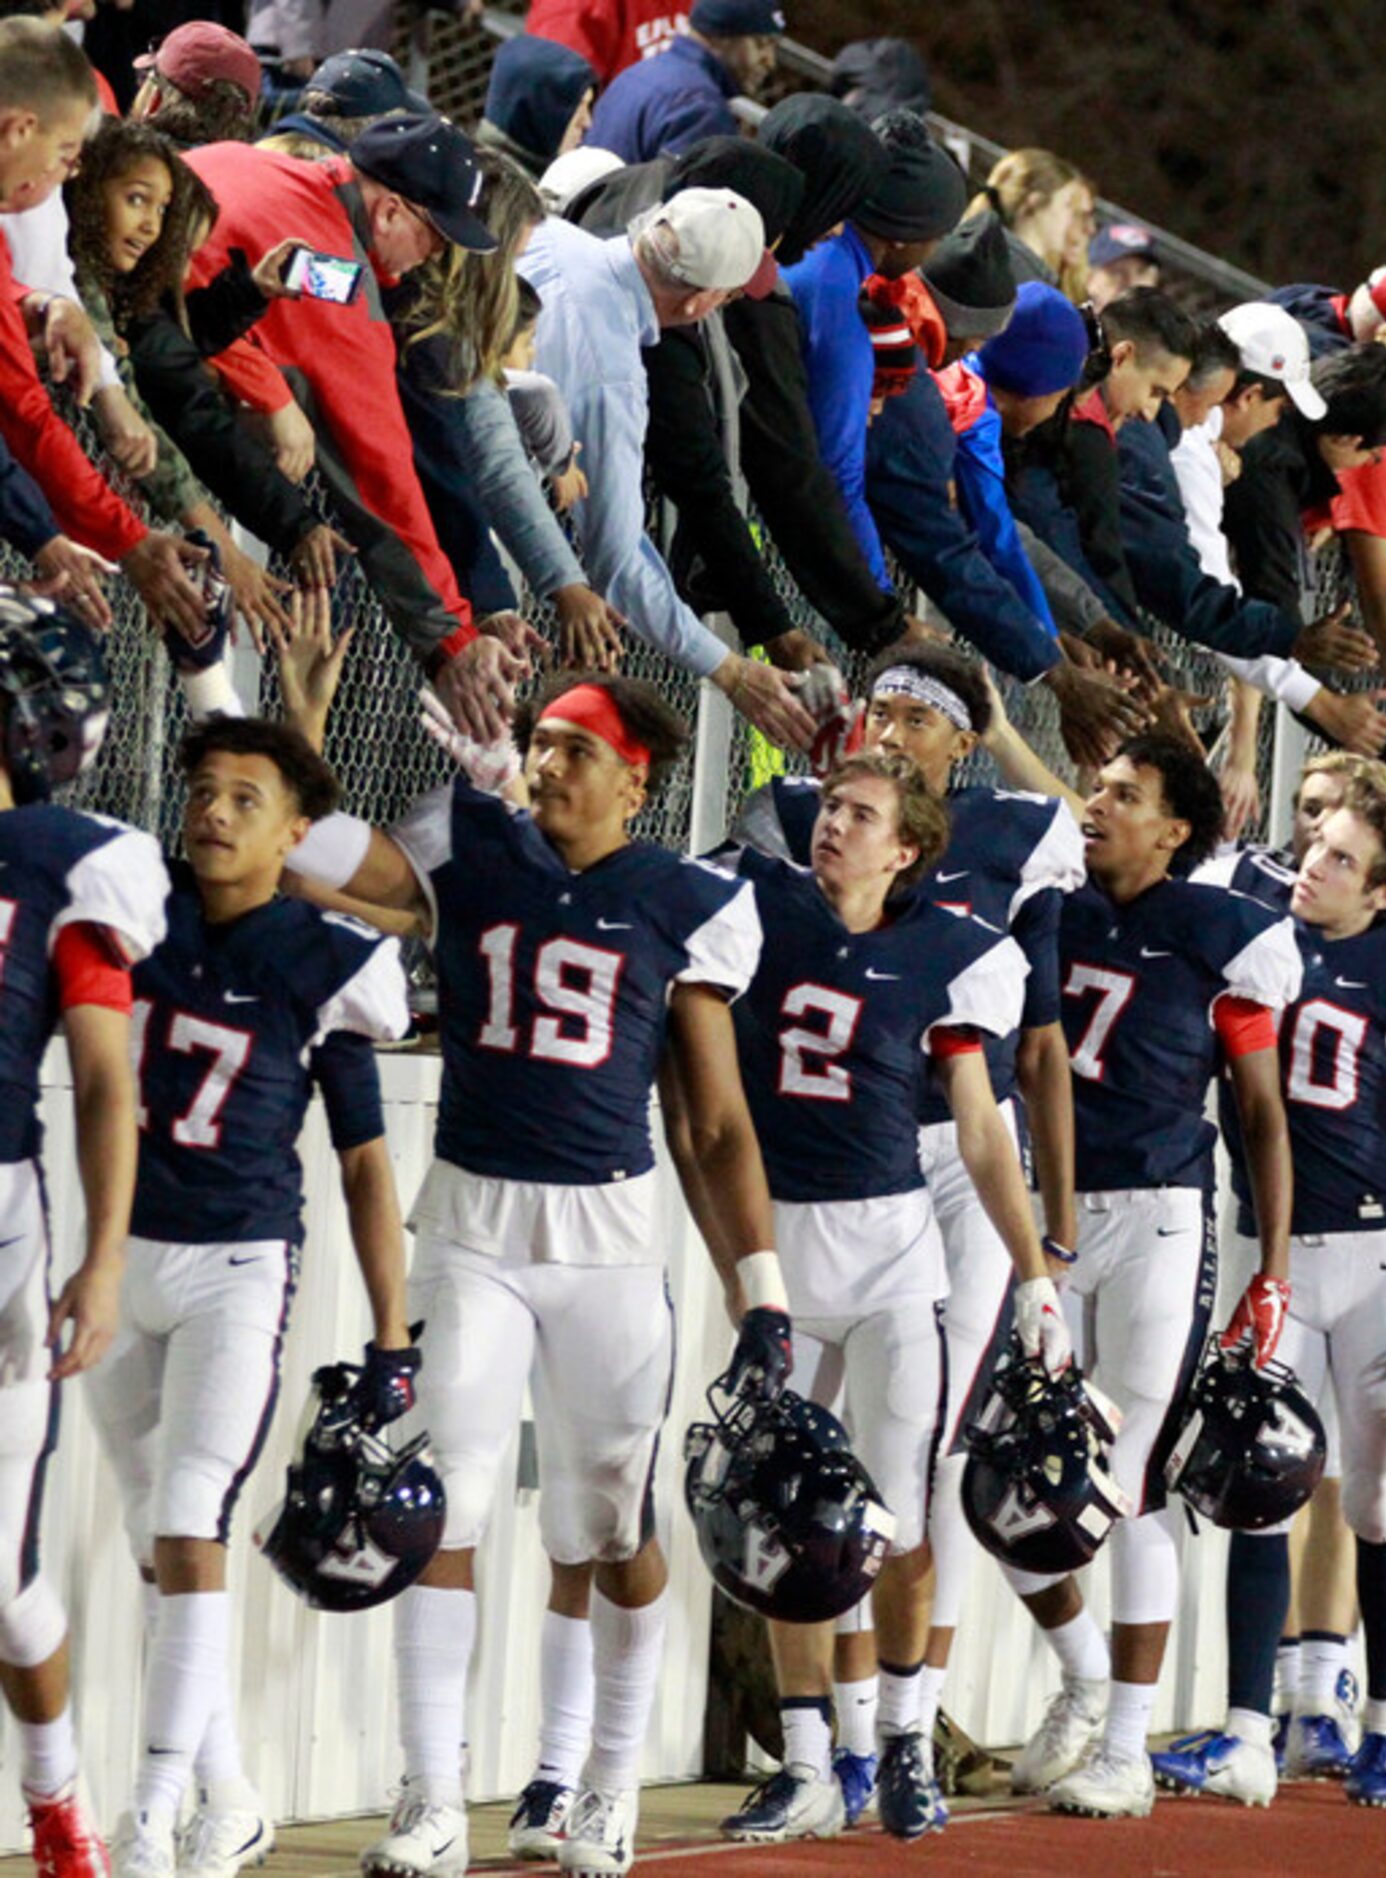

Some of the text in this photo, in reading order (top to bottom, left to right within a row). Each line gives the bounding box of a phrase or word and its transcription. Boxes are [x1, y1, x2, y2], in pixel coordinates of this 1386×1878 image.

[478, 917, 625, 1069] 19
[1063, 960, 1138, 1083] 7
[776, 981, 863, 1102] 2
[1255, 1402, 1316, 1461] A
[990, 1478, 1057, 1543] A
[317, 1518, 402, 1590] A
[745, 1520, 793, 1594] A
